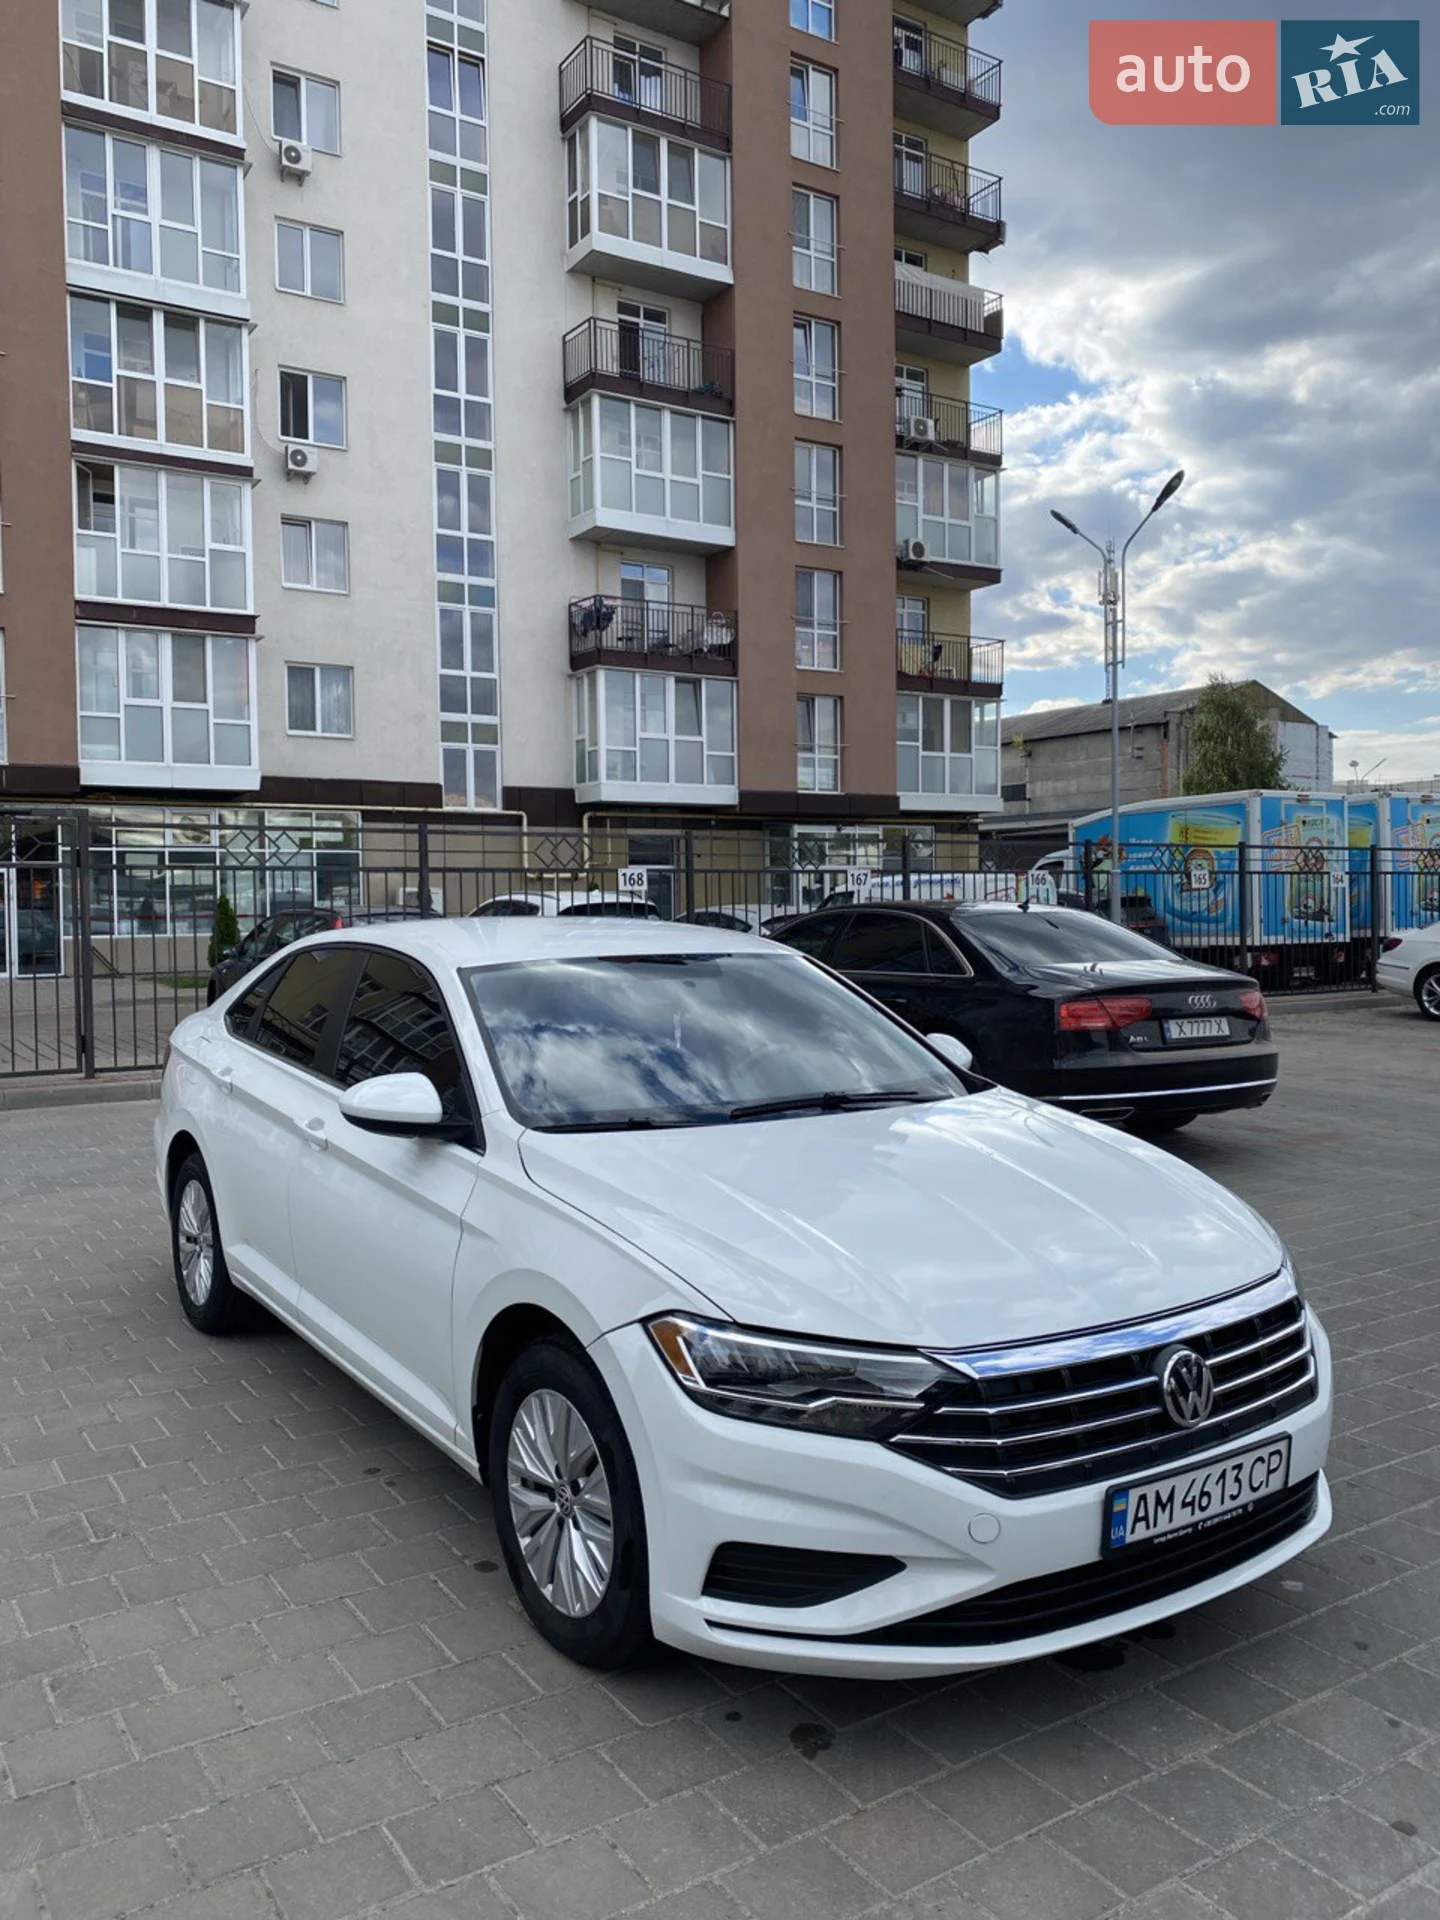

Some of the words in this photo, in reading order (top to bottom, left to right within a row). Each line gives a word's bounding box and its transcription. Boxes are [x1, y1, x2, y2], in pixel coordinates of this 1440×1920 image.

[621, 872, 644, 887] 168
[850, 873, 868, 886] 167
[1031, 873, 1047, 886] 166
[1193, 873, 1207, 885] 165
[1111, 1524, 1125, 1540] UA
